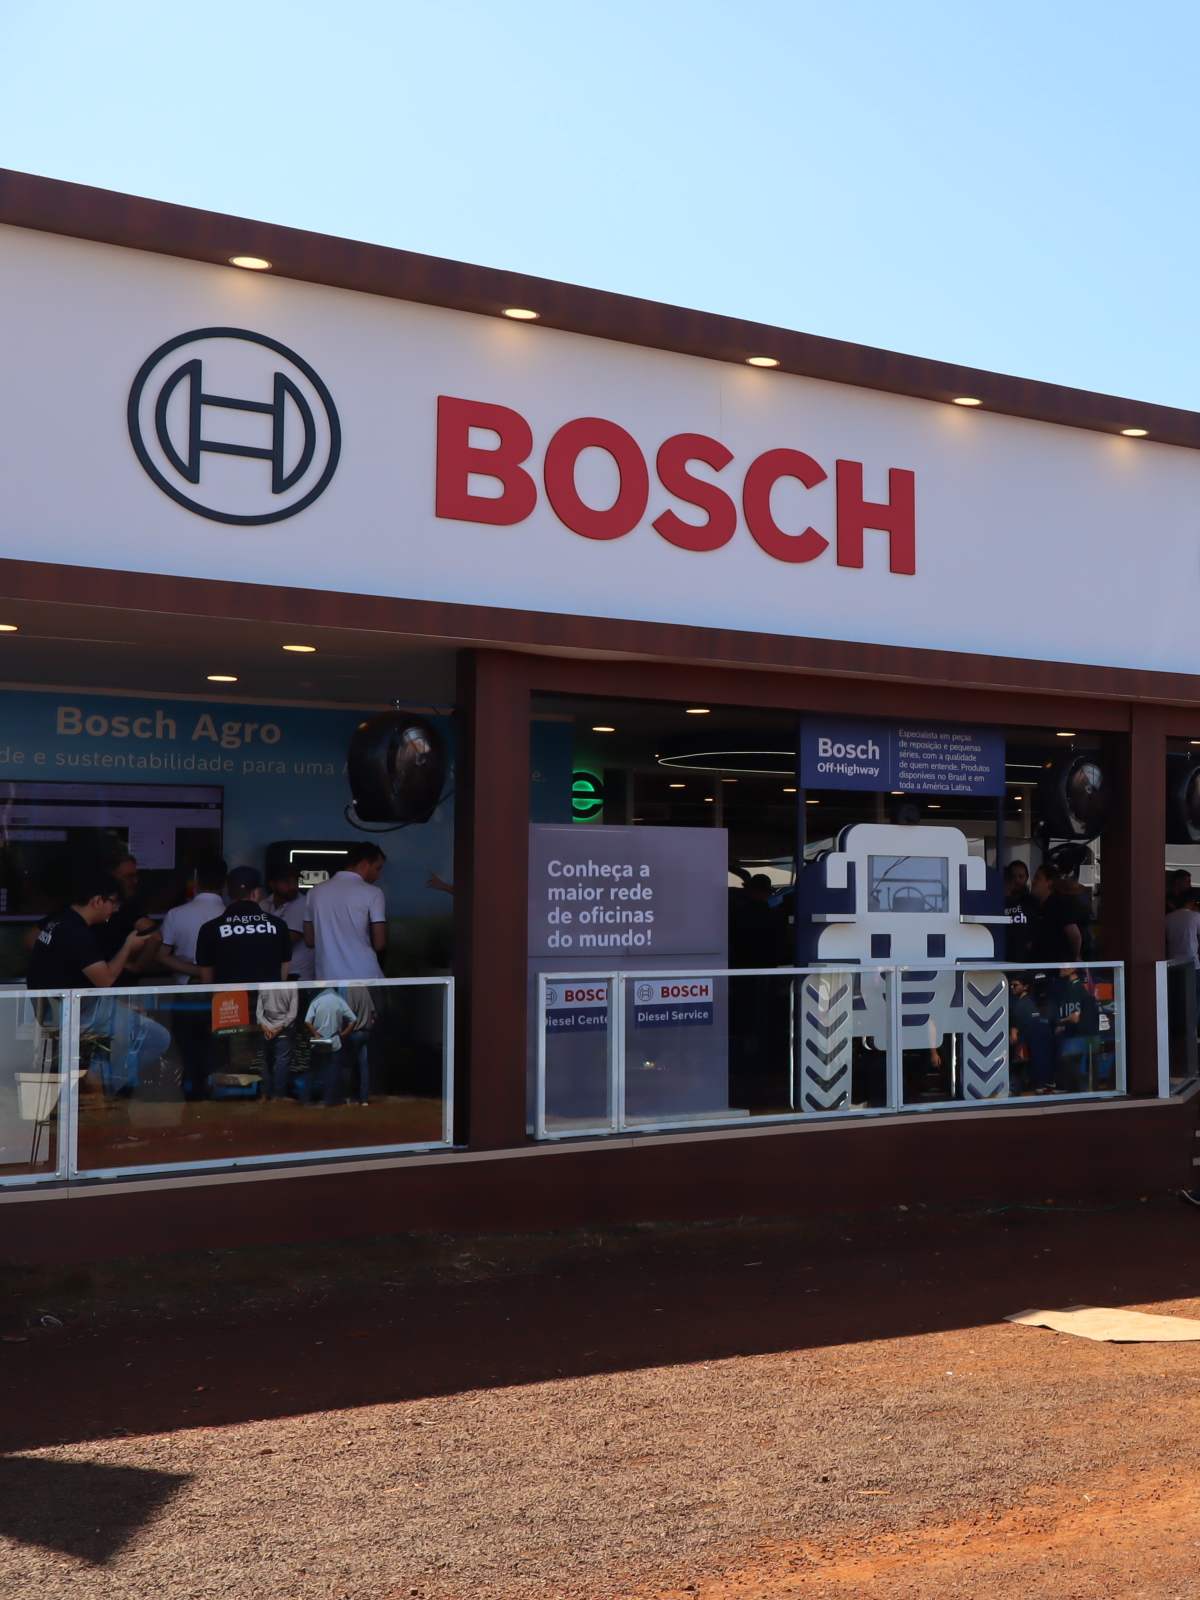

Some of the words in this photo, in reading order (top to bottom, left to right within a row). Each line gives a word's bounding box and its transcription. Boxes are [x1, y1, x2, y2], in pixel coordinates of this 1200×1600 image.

[435, 395, 916, 576] BOSCH
[56, 706, 177, 739] Bosch
[191, 713, 281, 749] Agro
[899, 729, 938, 741] Especialista
[952, 734, 971, 742] peças
[818, 737, 880, 760] Bosch
[899, 739, 908, 748] de
[909, 741, 942, 751] reposição
[949, 743, 981, 752] pequenas
[34, 751, 46, 765] e
[55, 751, 234, 772] sustentabilidade
[243, 758, 285, 775] para
[294, 761, 334, 775] uma
[922, 752, 937, 760] com
[944, 752, 977, 763] qualidade
[817, 762, 880, 777] Off-Highway
[899, 760, 908, 769] de
[909, 763, 929, 771] quem
[930, 762, 959, 771] entende.
[961, 764, 990, 773] Produtos
[948, 773, 967, 782] Brasil
[899, 781, 915, 790] toda
[922, 781, 949, 791] América
[951, 782, 973, 792] Latina.
[547, 860, 633, 882] Conheça
[640, 864, 650, 877] a
[548, 883, 604, 900] maior
[610, 883, 653, 900] rede
[547, 907, 572, 924] de
[579, 906, 654, 924] oficinas
[219, 921, 277, 938] Bosch
[547, 930, 573, 948] do
[580, 929, 652, 947] mundo!
[564, 988, 608, 1002] BOSC
[661, 984, 709, 999] BOSCH
[578, 1014, 608, 1025] Cente
[637, 1011, 669, 1022] Diesel
[671, 1010, 709, 1020] Service
